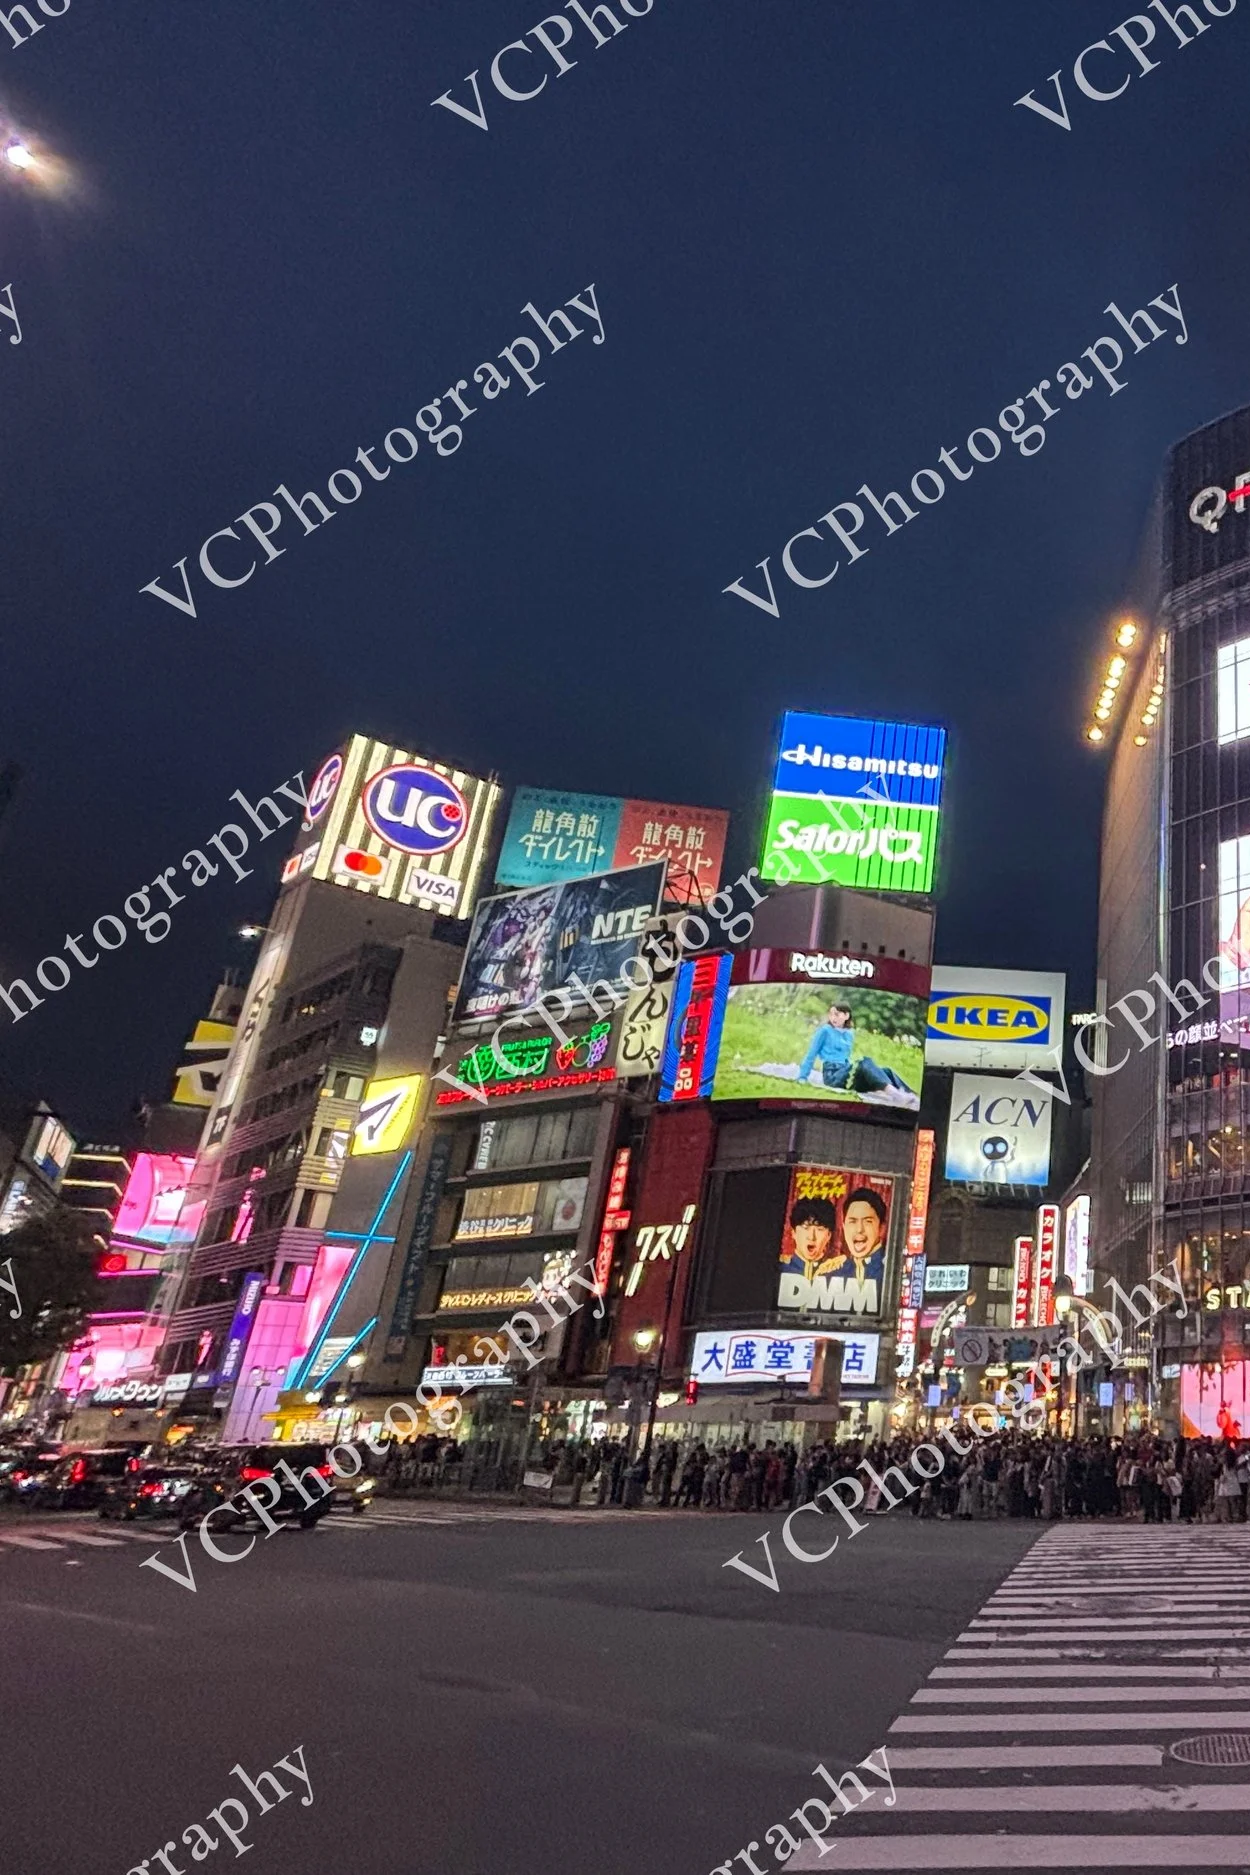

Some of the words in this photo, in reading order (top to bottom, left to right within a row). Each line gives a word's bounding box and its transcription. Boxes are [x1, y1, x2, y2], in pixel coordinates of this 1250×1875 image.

[782, 744, 939, 779] Hisamitsu
[376, 778, 456, 838] UC
[531, 808, 599, 839] 龍角散
[642, 822, 706, 851] 龍角散
[414, 874, 456, 900] VISA
[592, 905, 653, 937] NTE
[791, 952, 875, 979] Rakuten
[935, 1006, 1040, 1029] IKEA
[953, 1094, 1050, 1129] ACN
[1041, 1215, 1055, 1280] カラオケ
[778, 1272, 878, 1313] DMM
